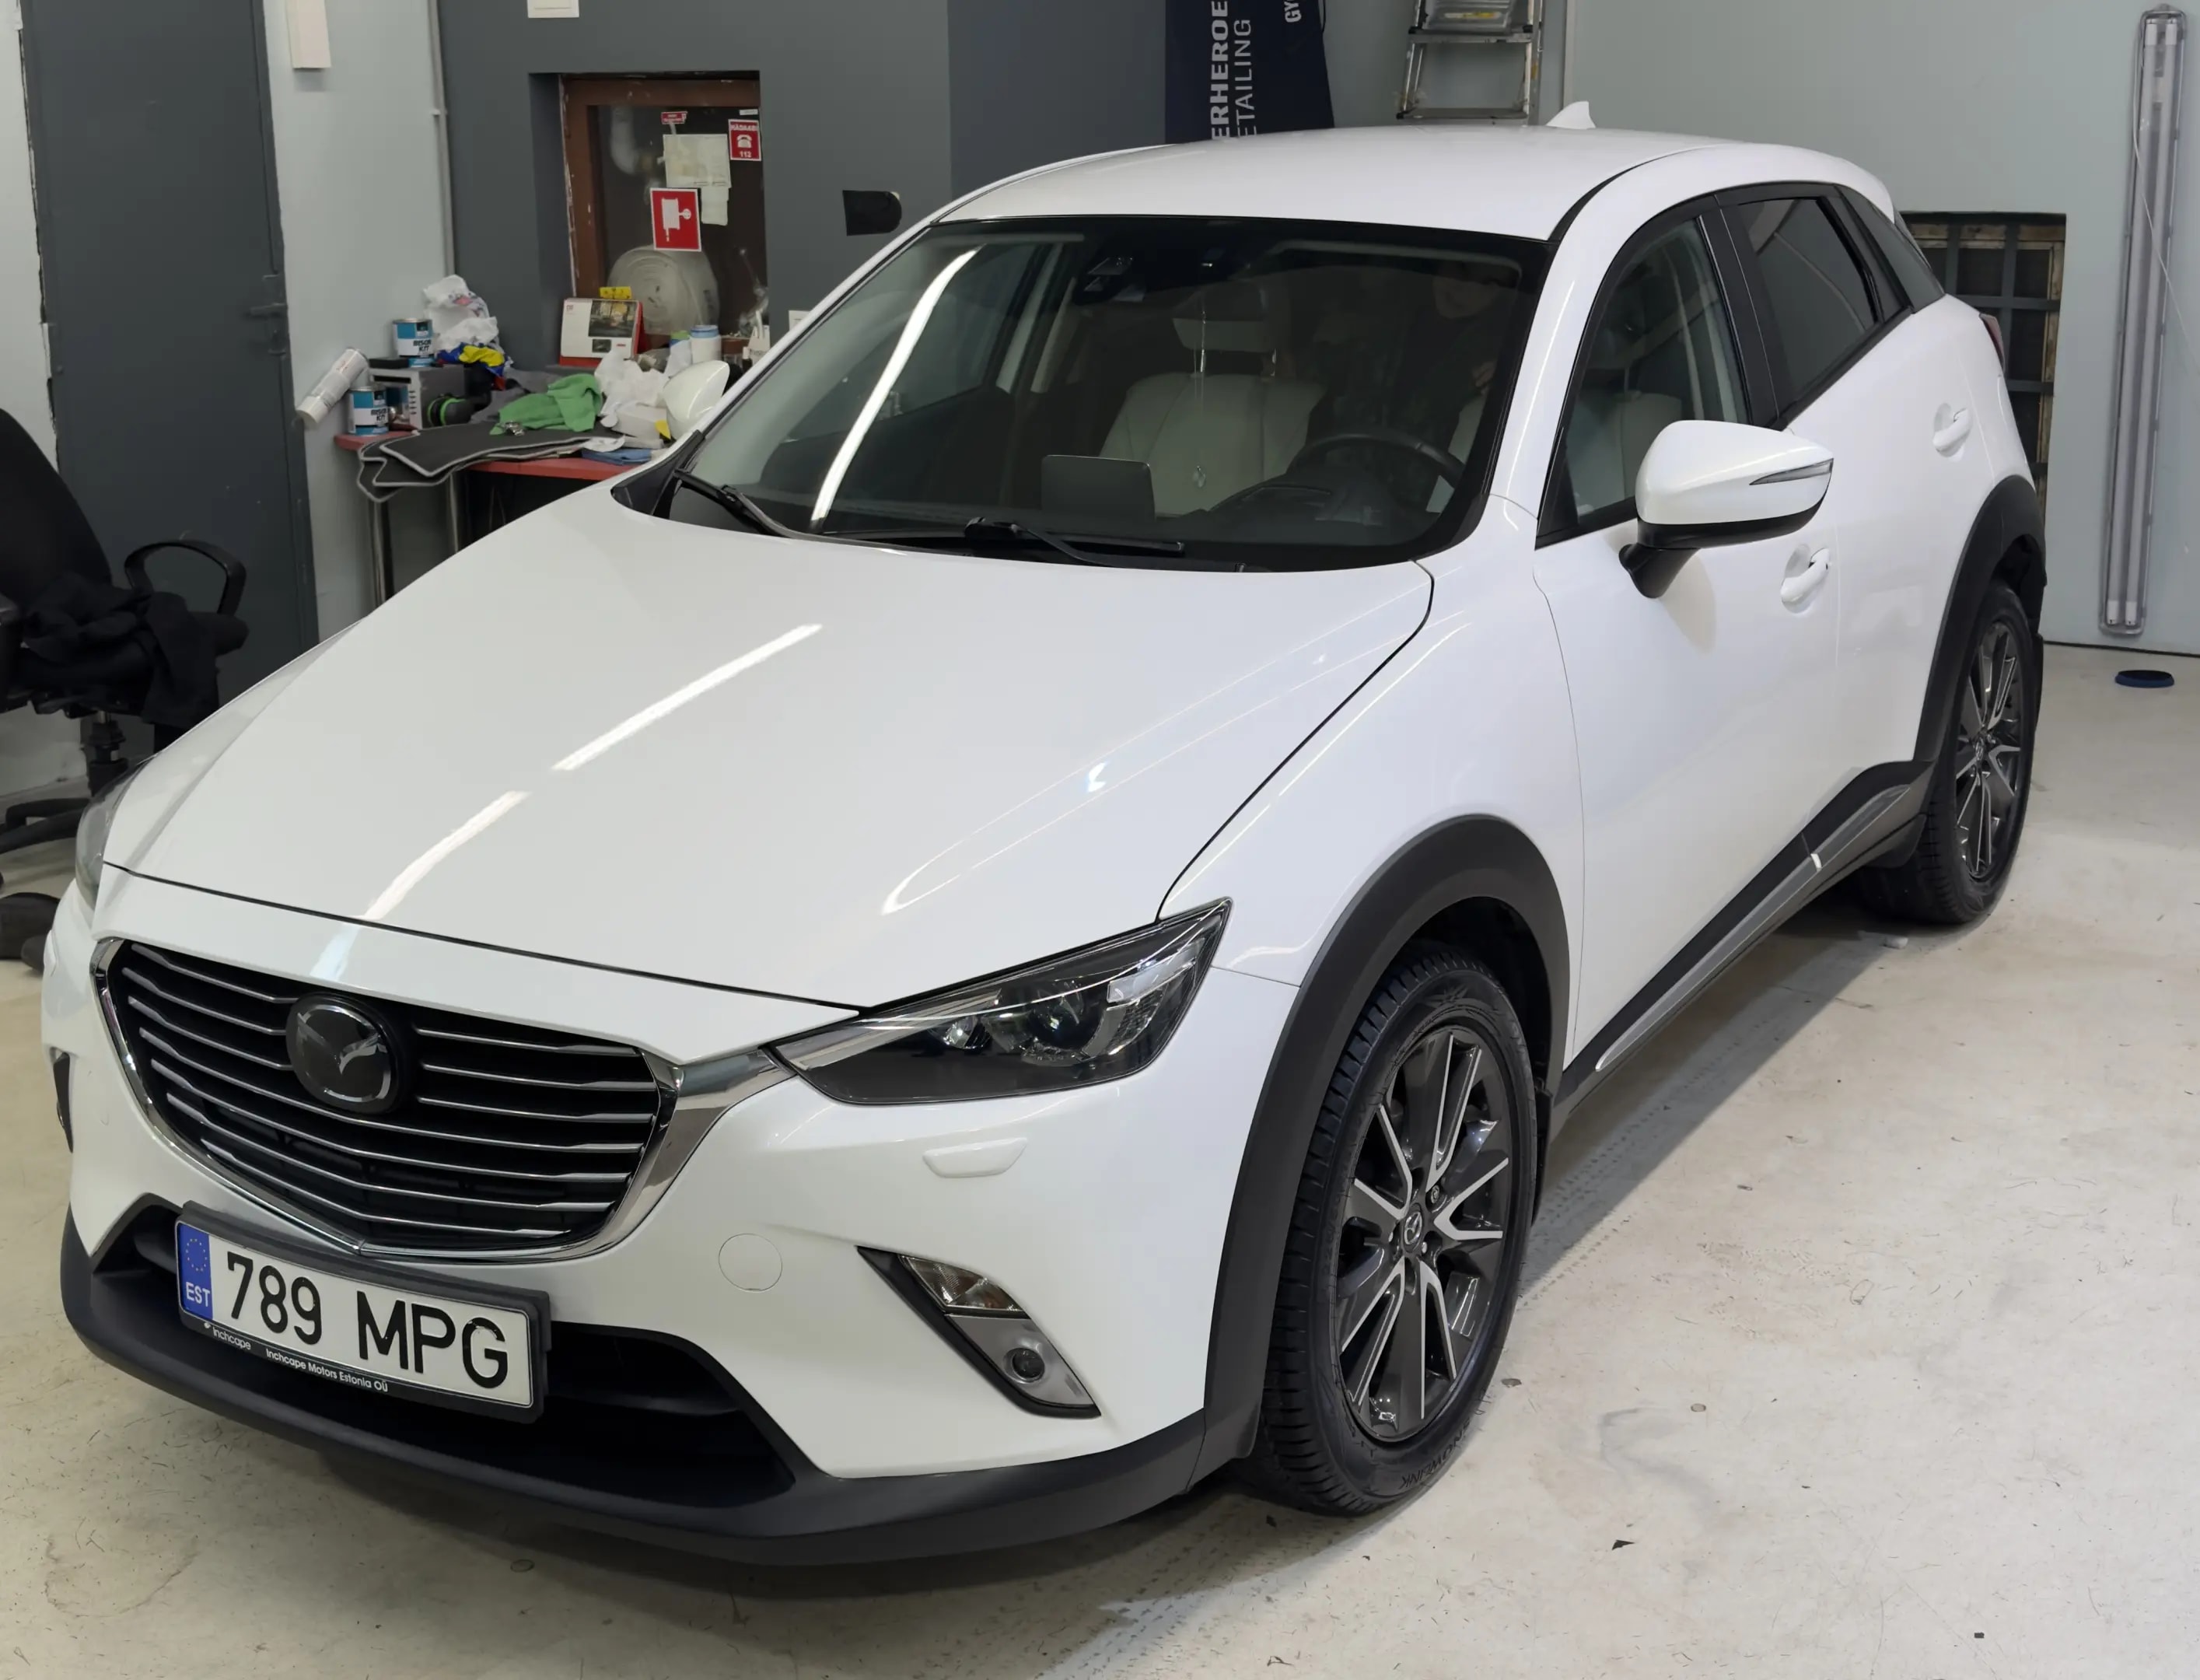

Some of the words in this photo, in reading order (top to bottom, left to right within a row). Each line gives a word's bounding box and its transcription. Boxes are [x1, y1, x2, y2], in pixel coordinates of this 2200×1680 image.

[1284, 0, 1302, 23] GY
[186, 1281, 211, 1307] EST
[227, 1251, 322, 1346] 789
[357, 1290, 509, 1389] MPG
[212, 1325, 251, 1350] Inchcape
[266, 1348, 306, 1370] Inchcape
[308, 1361, 338, 1380] Motors
[339, 1371, 372, 1389] Estonia
[373, 1380, 388, 1393] OÜ
